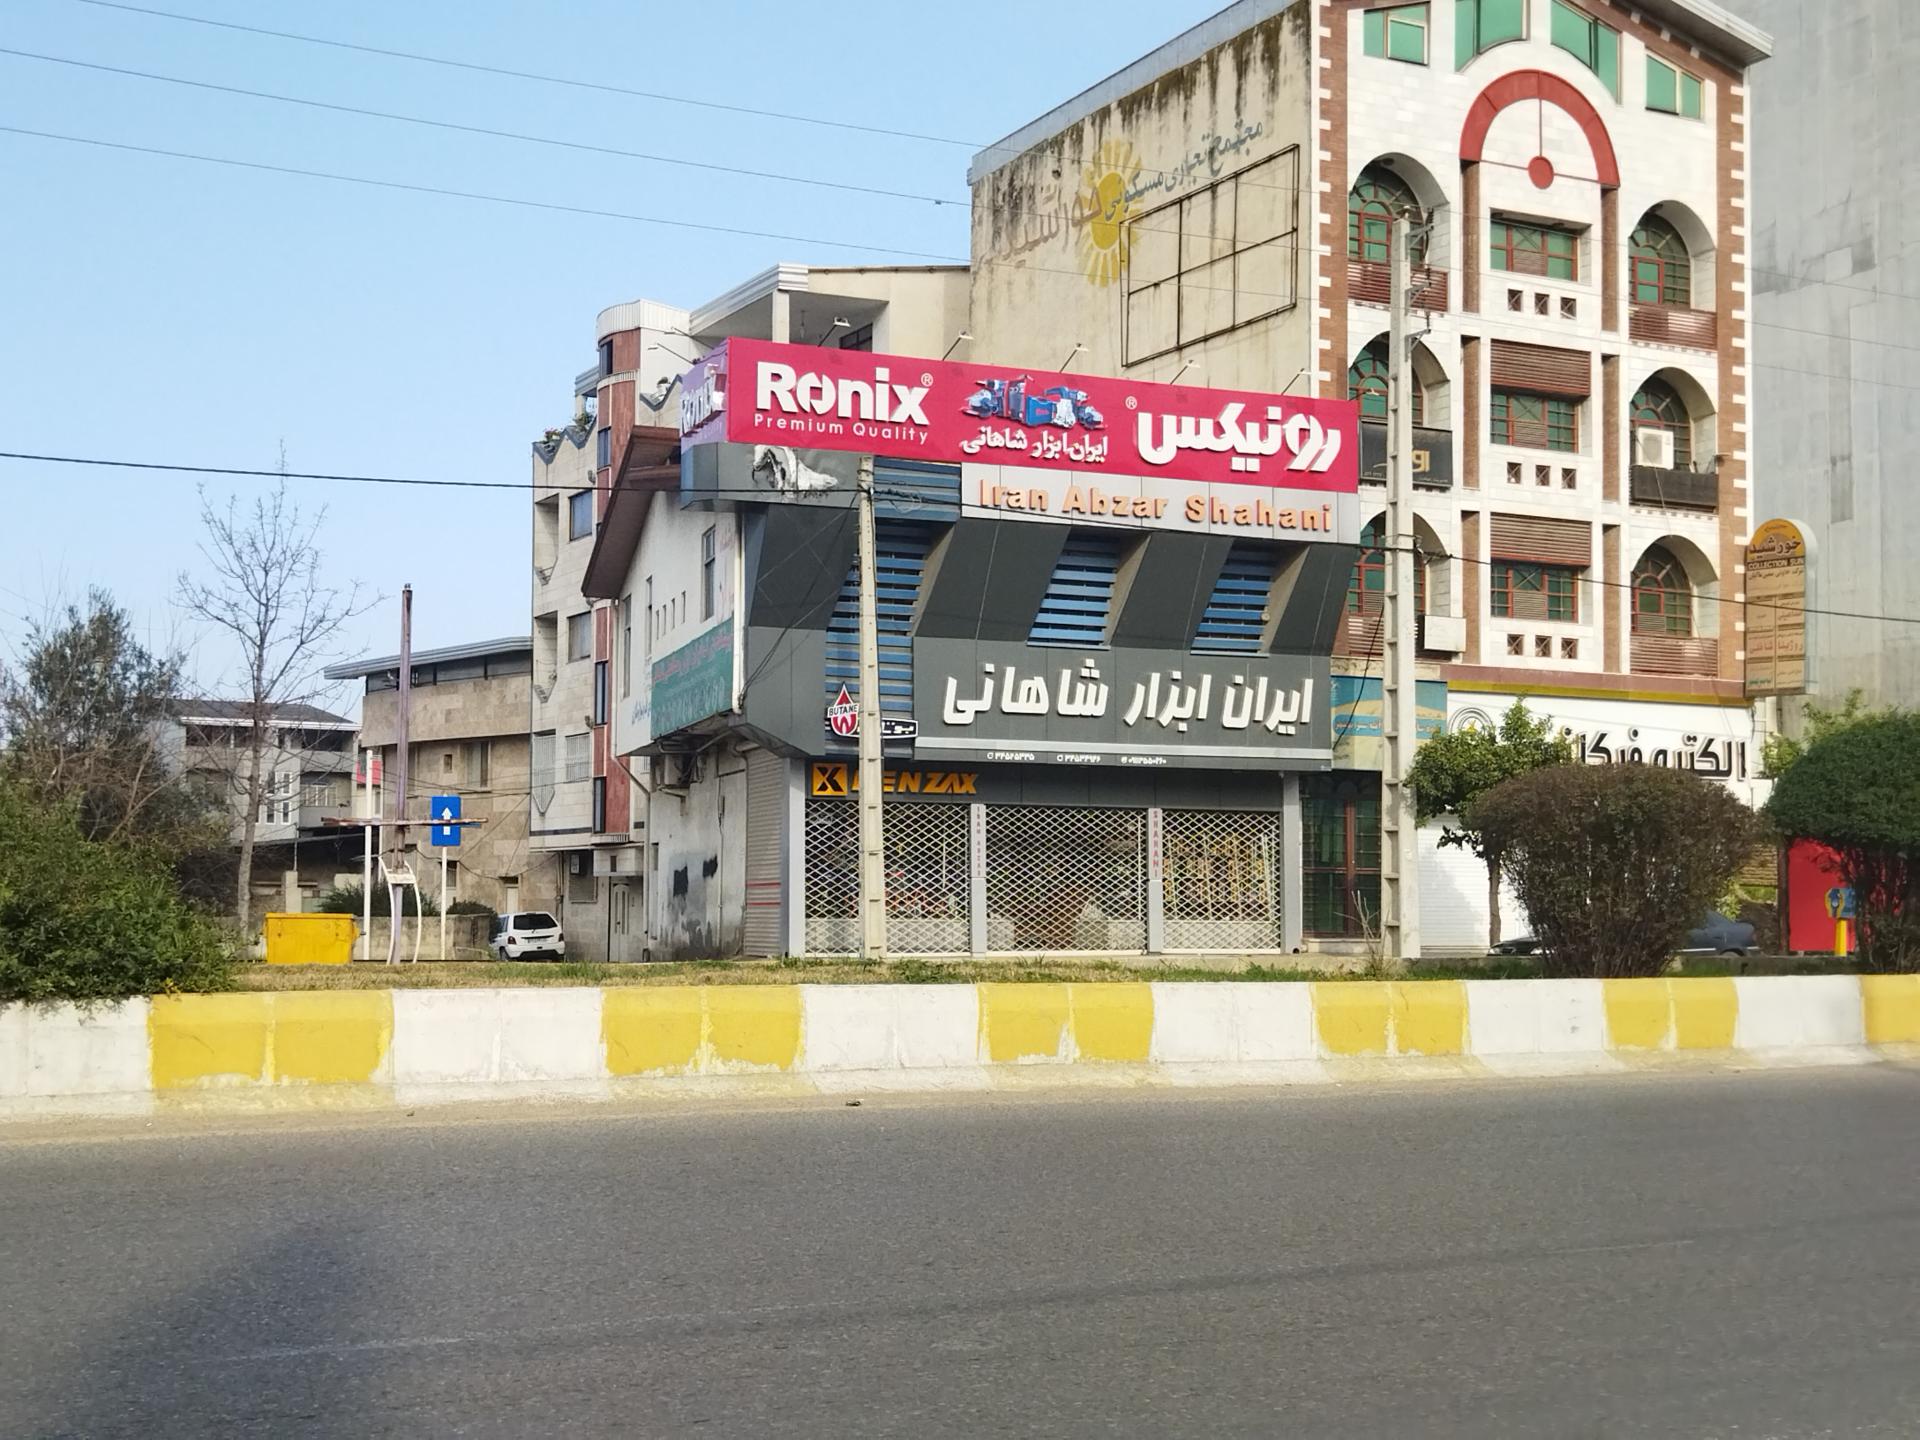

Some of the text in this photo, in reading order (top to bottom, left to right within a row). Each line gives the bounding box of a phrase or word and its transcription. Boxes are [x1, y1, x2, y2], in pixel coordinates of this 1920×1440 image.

[755, 360, 931, 427] Ronix
[753, 413, 929, 446] Premium Quality
[961, 426, 1109, 463] ایران ابزار شاهانی
[1137, 401, 1342, 473] رونیکس
[979, 478, 1333, 533] Iran Abzar Shahani
[827, 703, 859, 717] BUTANE
[943, 658, 1313, 736] ایران ابزار شاهانی
